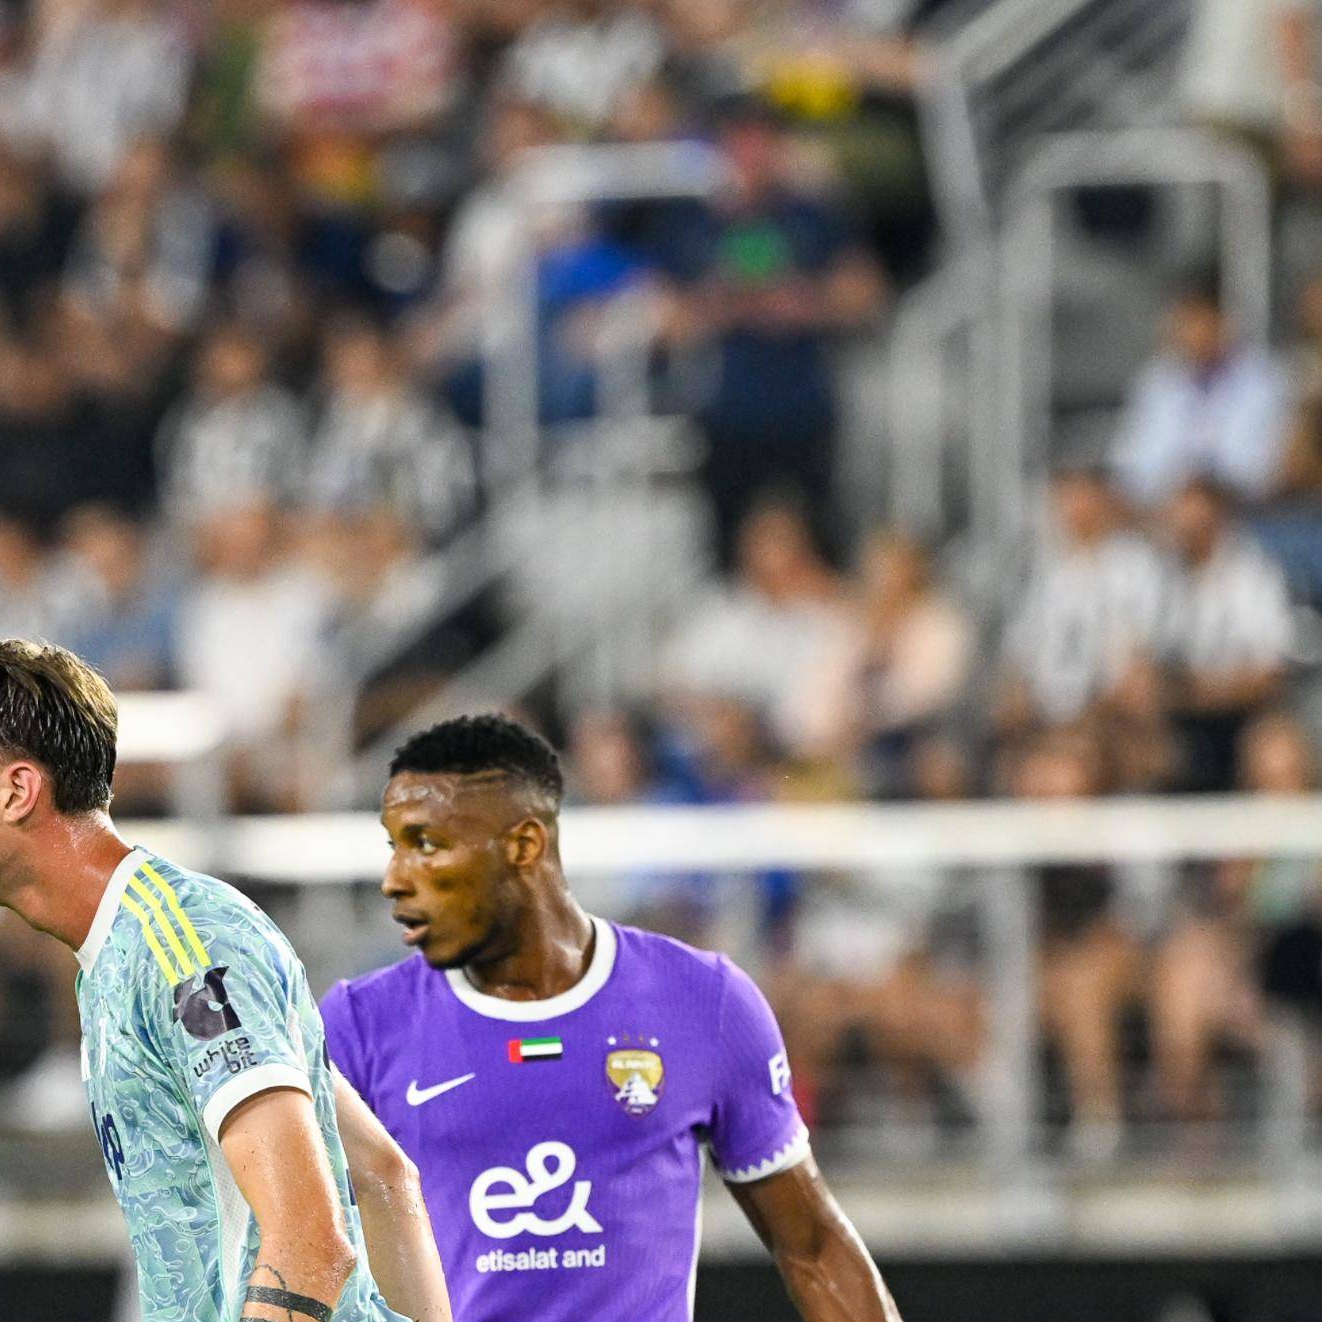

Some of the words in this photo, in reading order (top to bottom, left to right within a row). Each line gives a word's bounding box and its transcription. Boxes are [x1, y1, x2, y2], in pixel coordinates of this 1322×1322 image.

[193, 1036, 251, 1078] white
[222, 1050, 258, 1074] bit
[475, 1247, 559, 1273] etisalat
[561, 1244, 606, 1269] and
